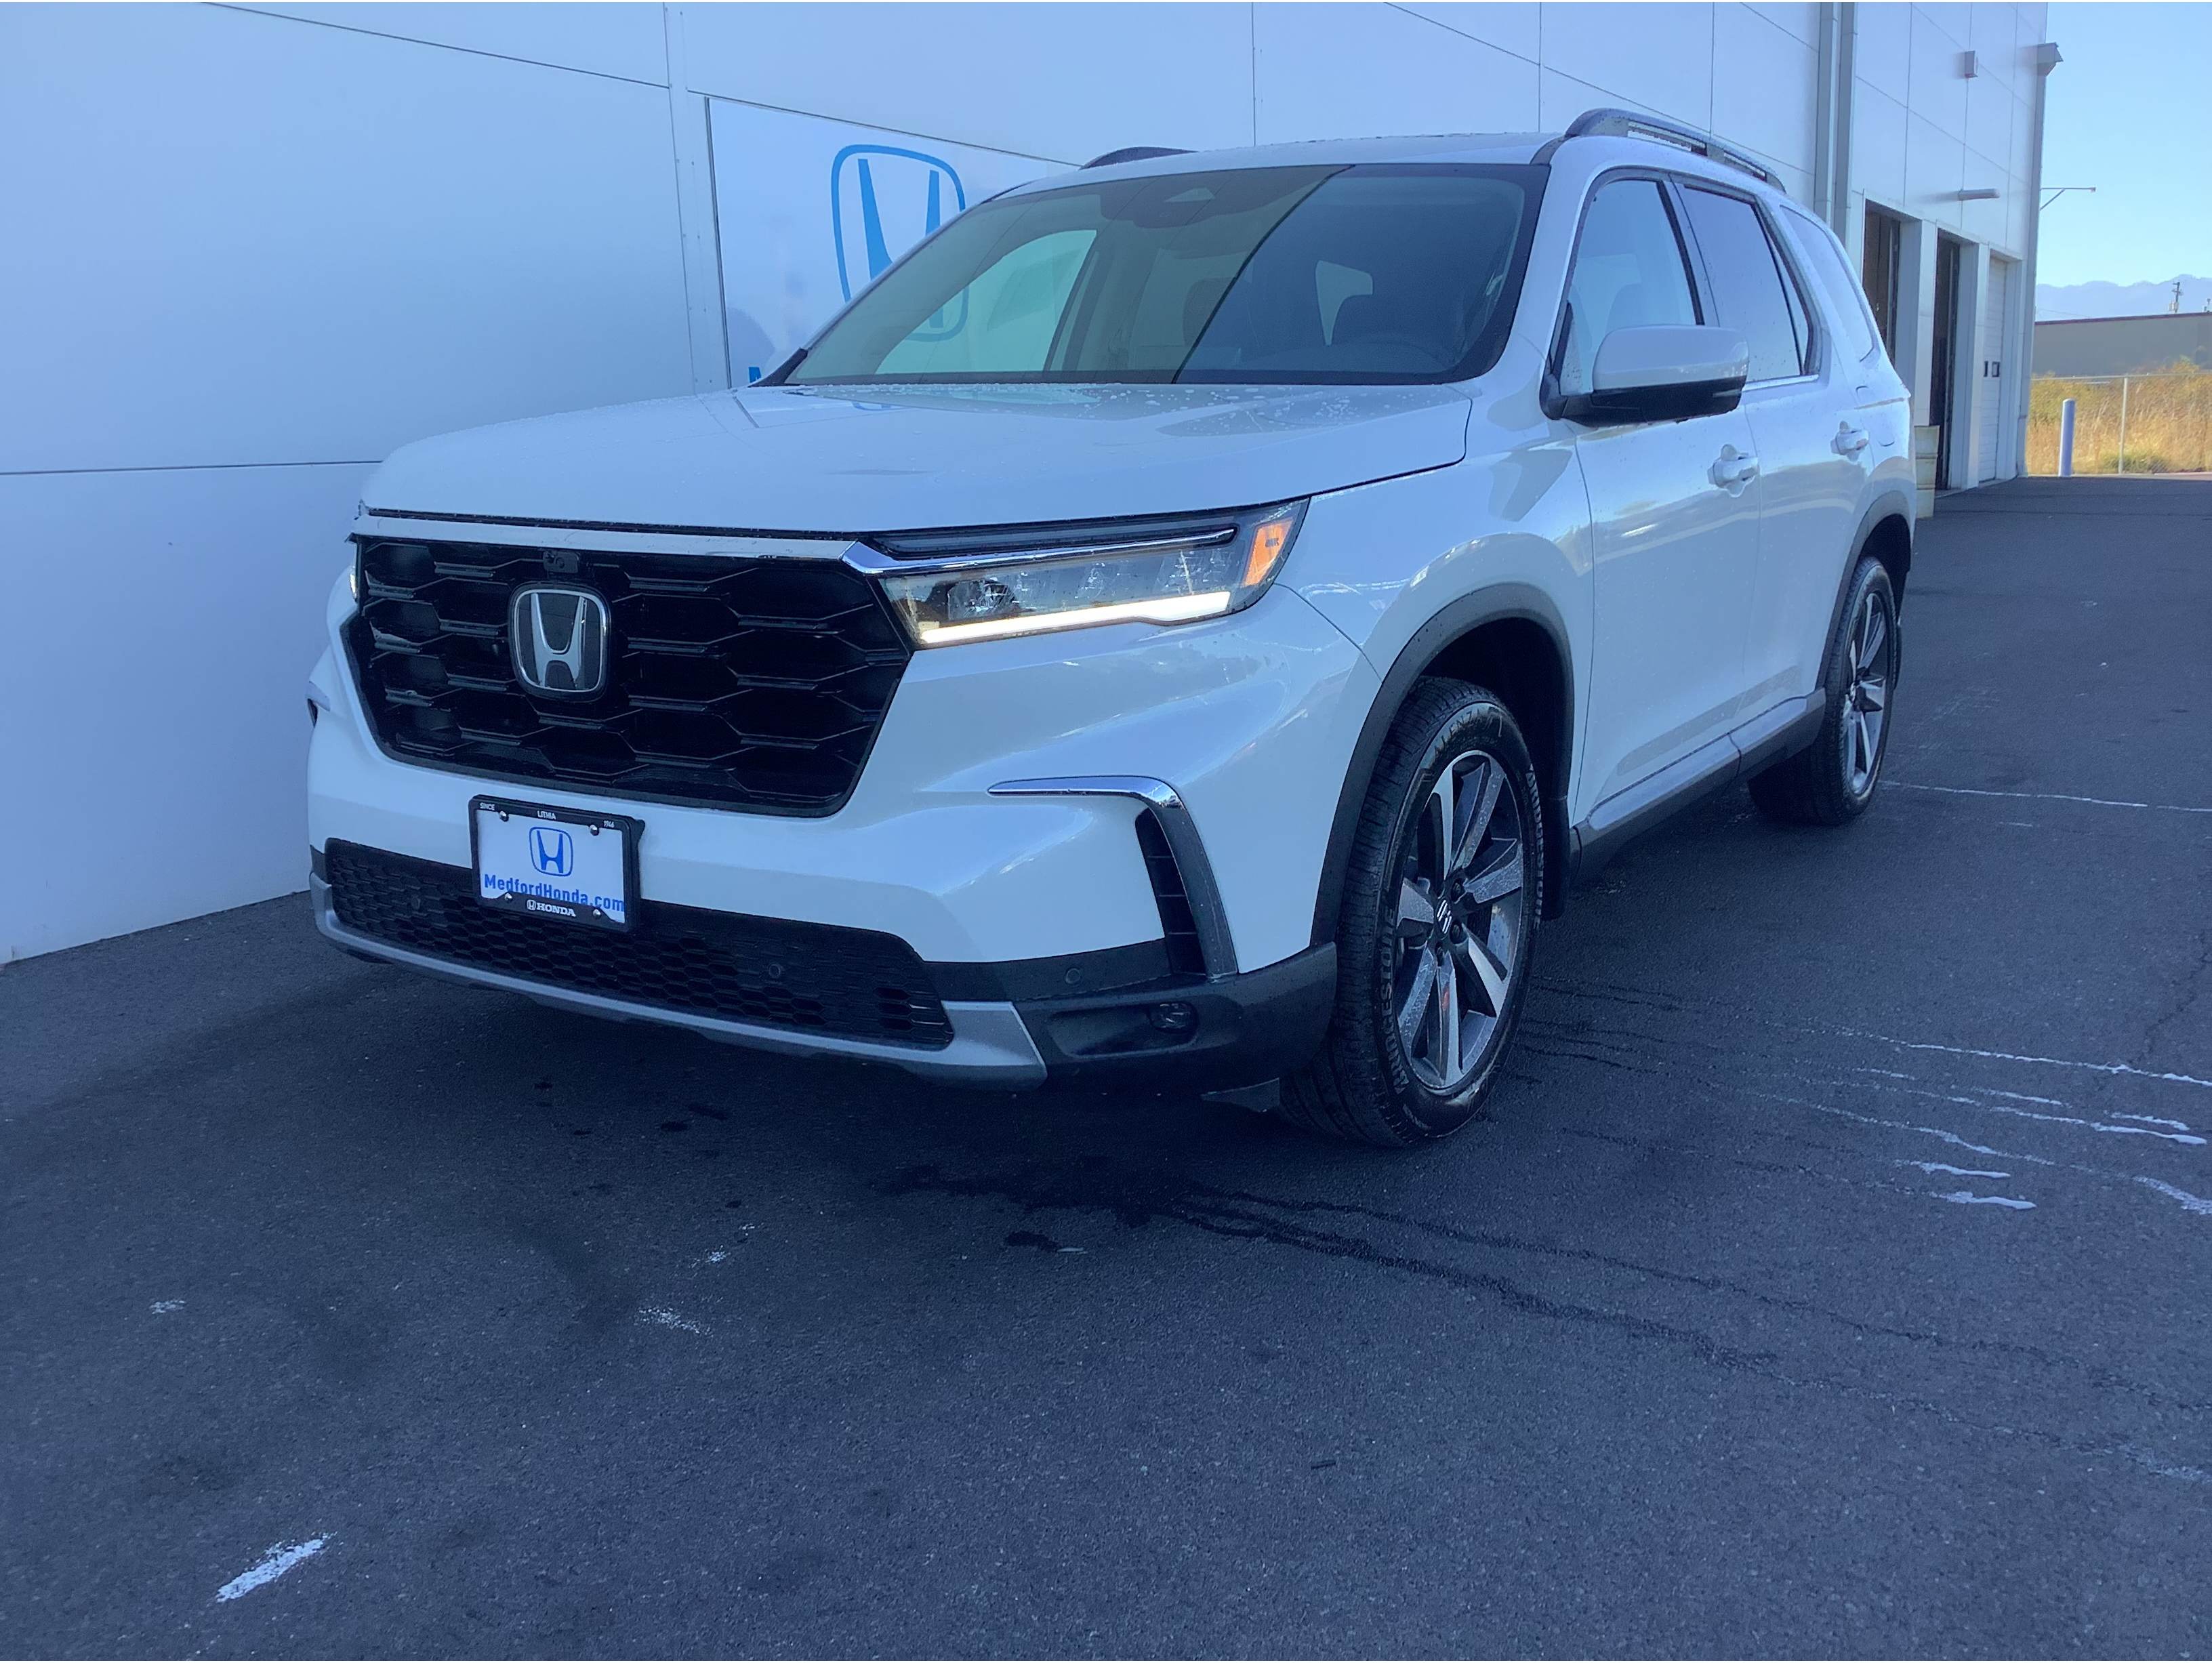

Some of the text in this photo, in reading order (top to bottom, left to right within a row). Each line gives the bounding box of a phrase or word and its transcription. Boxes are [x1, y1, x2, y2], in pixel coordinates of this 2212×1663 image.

[480, 802, 495, 811] SINCE
[537, 810, 556, 820] LITHIA
[603, 820, 615, 828] 1946
[484, 874, 625, 912] MedfordHonda.com
[536, 902, 576, 917] HONDA
